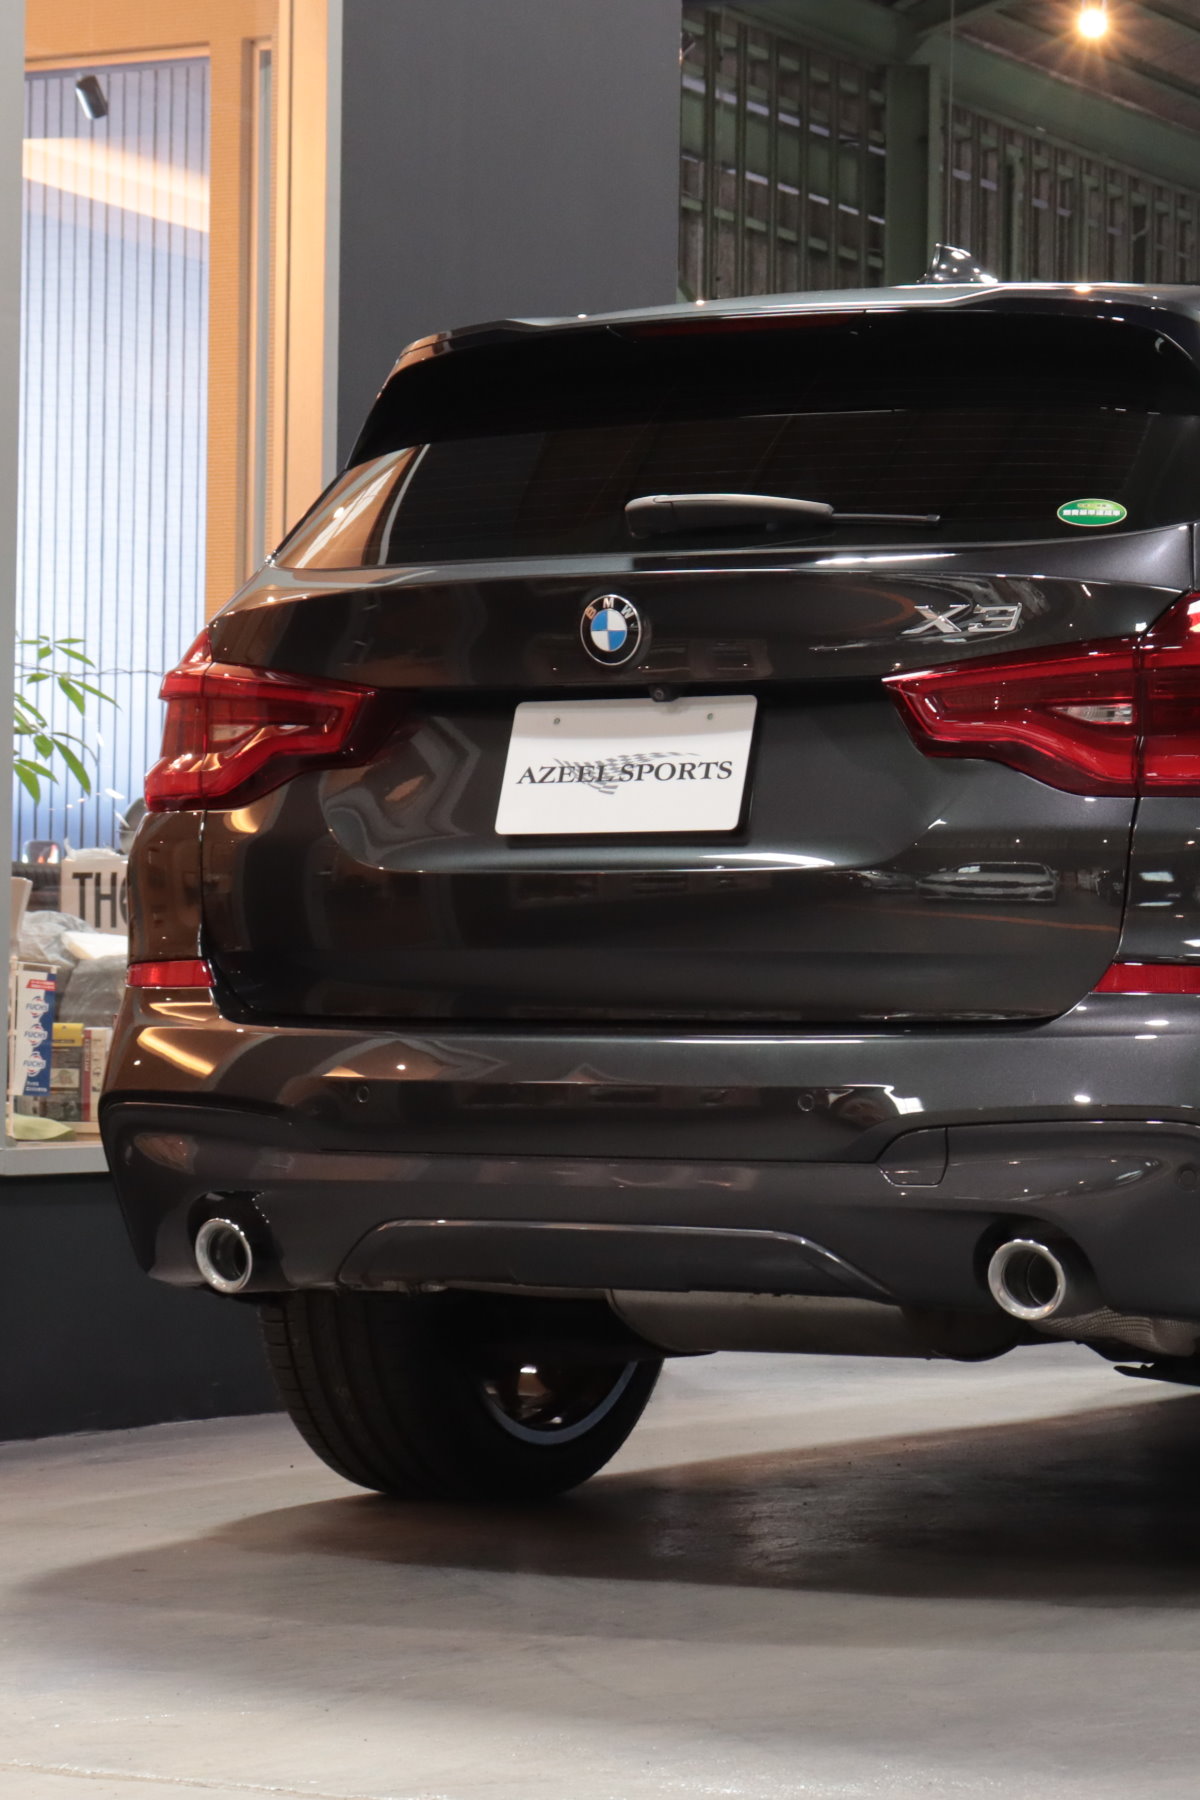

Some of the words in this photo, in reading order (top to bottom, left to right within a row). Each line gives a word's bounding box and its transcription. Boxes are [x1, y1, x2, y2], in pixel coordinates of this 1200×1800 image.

[585, 597, 635, 619] BMW
[901, 602, 1022, 634] X3
[516, 765, 614, 784] AZEEL
[618, 760, 733, 782] SPORTS
